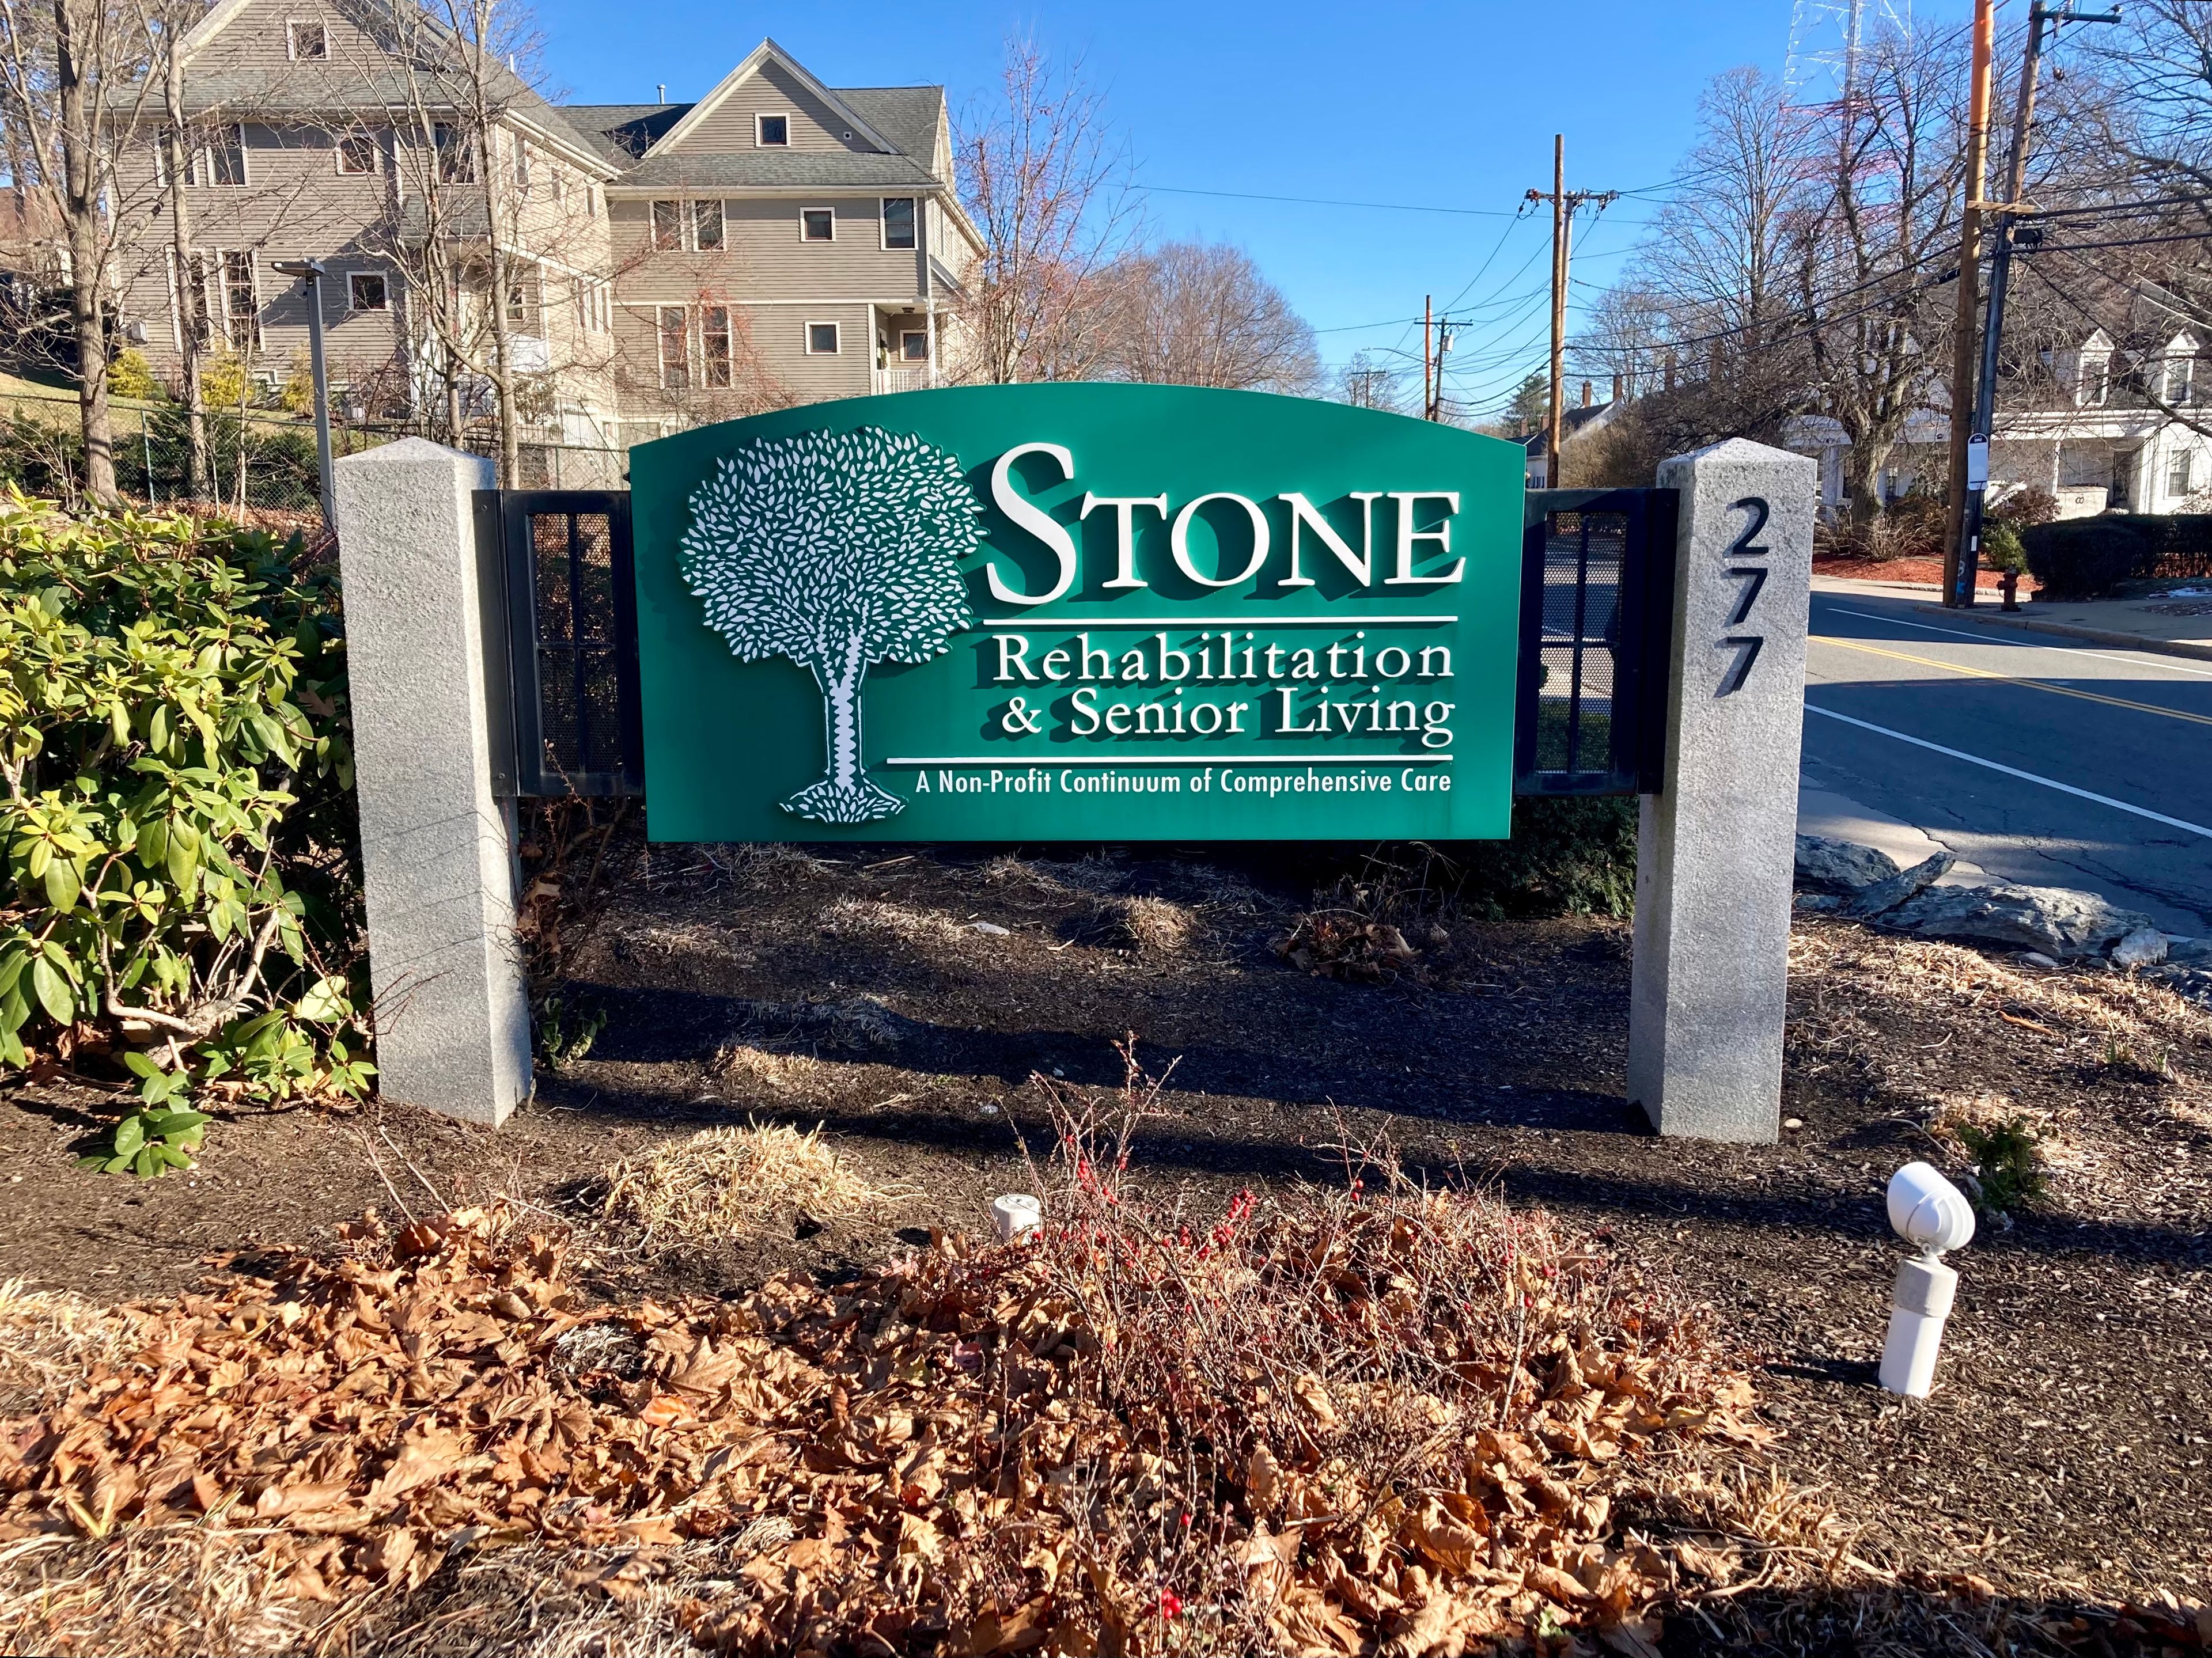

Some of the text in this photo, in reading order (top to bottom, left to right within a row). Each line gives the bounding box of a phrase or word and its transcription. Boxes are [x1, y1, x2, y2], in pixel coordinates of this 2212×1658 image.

[986, 442, 1466, 605] STONE
[1727, 496, 1770, 692] 277
[992, 631, 1455, 681] Rehabilitation
[1002, 685, 1456, 748] & Senior Living
[915, 767, 1452, 798] A Non-Profit Continuum of Comprehensive Care
